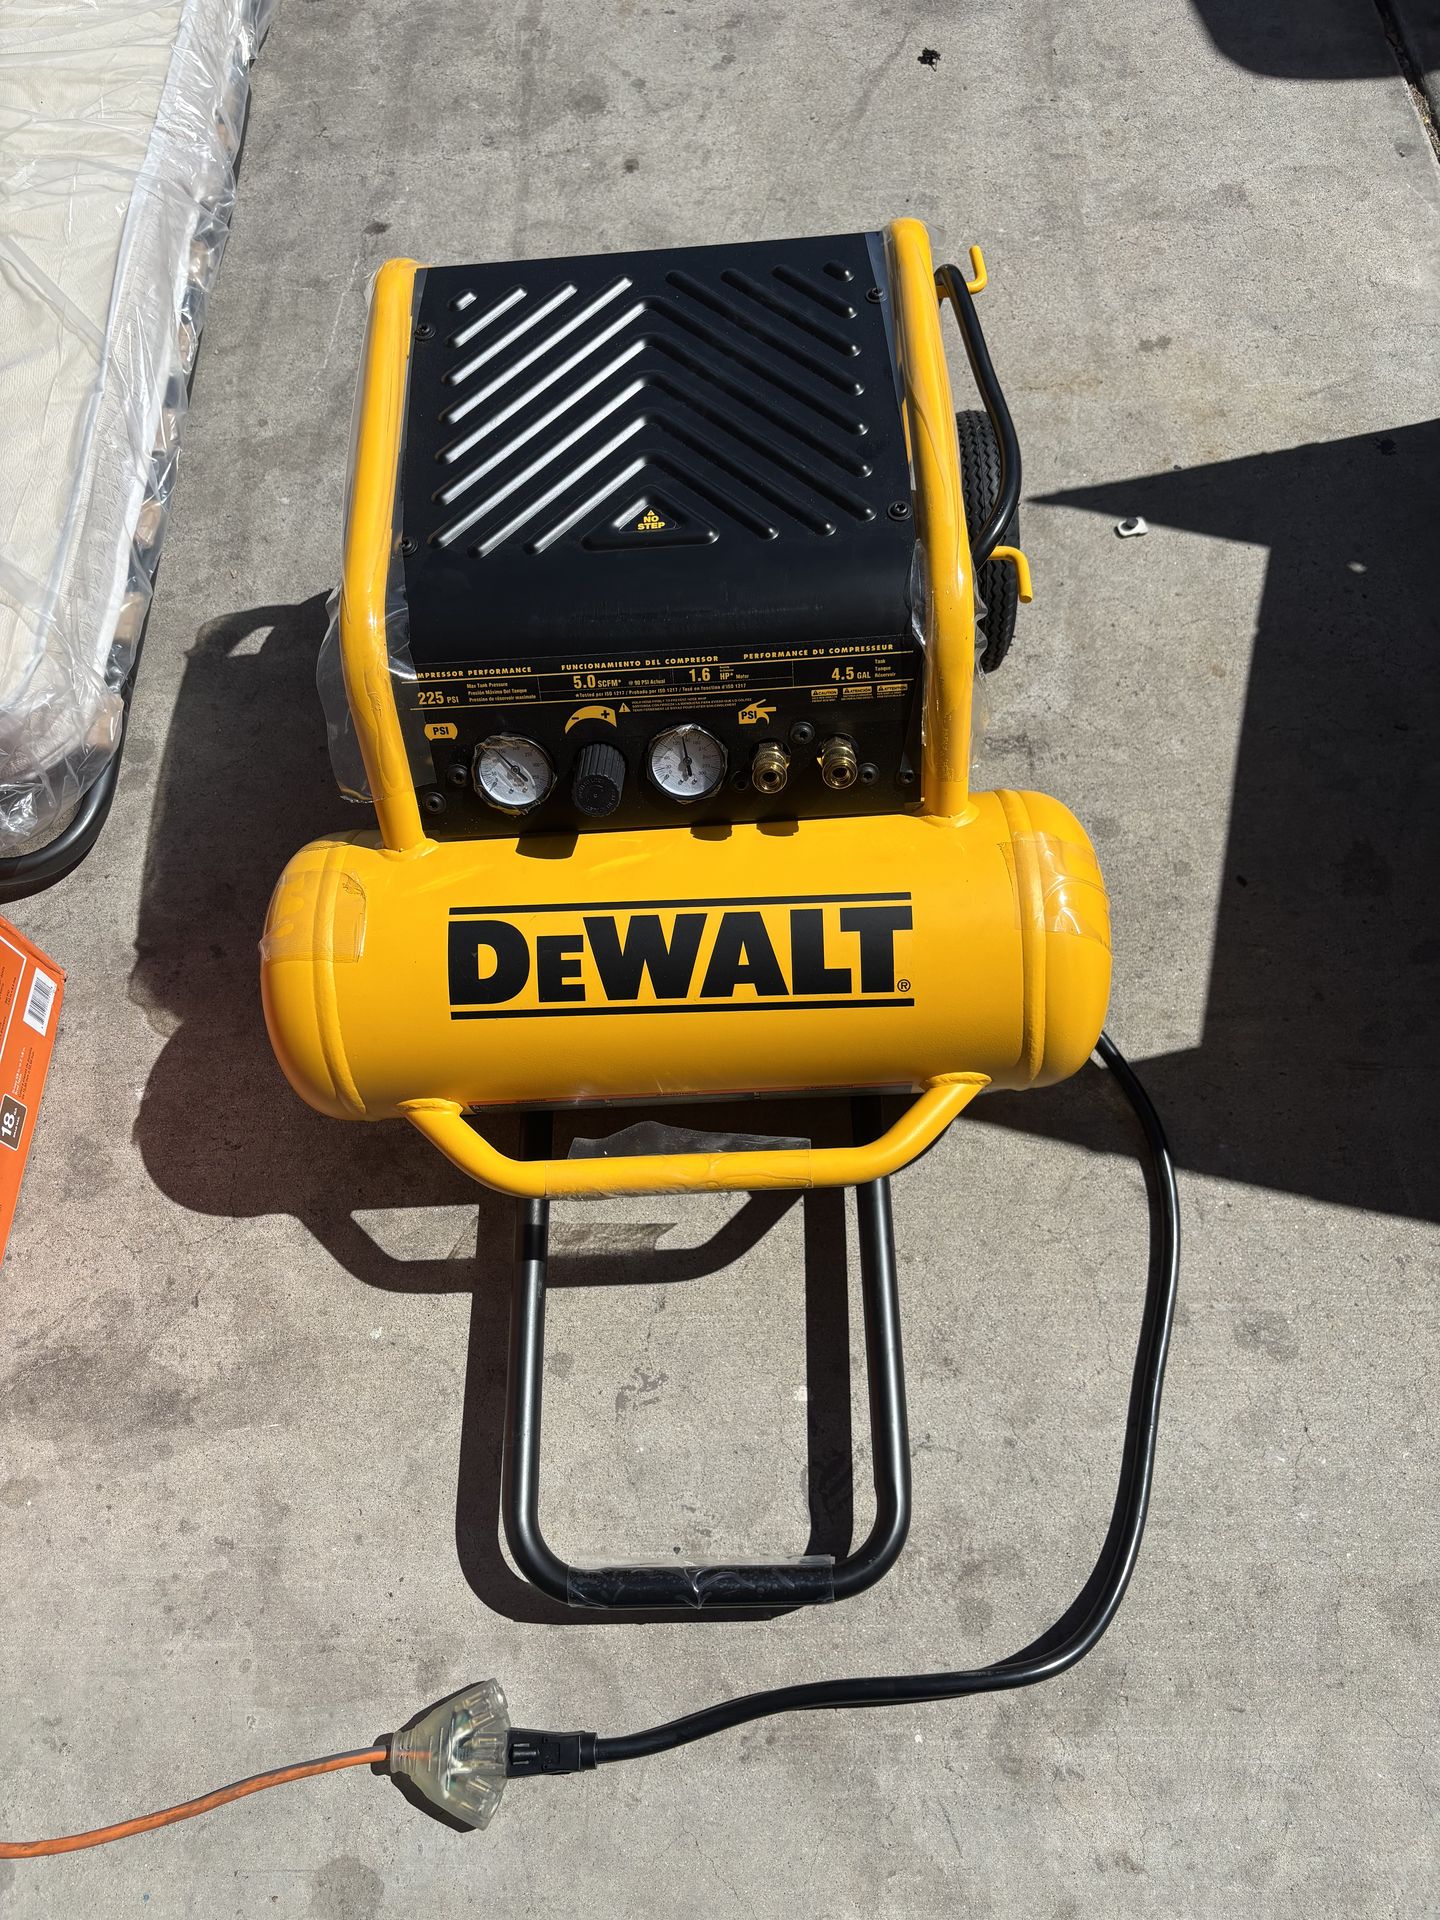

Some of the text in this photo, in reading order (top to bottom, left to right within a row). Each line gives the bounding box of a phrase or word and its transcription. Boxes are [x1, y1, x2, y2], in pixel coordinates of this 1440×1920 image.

[637, 521, 666, 530] STEP
[643, 515, 659, 523] NO
[743, 650, 809, 660] PERFORMANCE
[829, 644, 894, 654] COMPRESSEUR
[561, 655, 719, 671] FUNCIONAMIENTO DEL COMPRESOR
[417, 666, 532, 679] MPRESSOR PERFORMANCE
[689, 667, 711, 682] 1.6
[831, 666, 871, 680] 4.5 GAL
[573, 674, 596, 689] 5.0
[417, 691, 459, 705] 225 PSI
[741, 710, 757, 720] PSI
[432, 726, 449, 735] PSI
[447, 905, 913, 1006] DEWALT
[2, 1112, 15, 1136] 18
